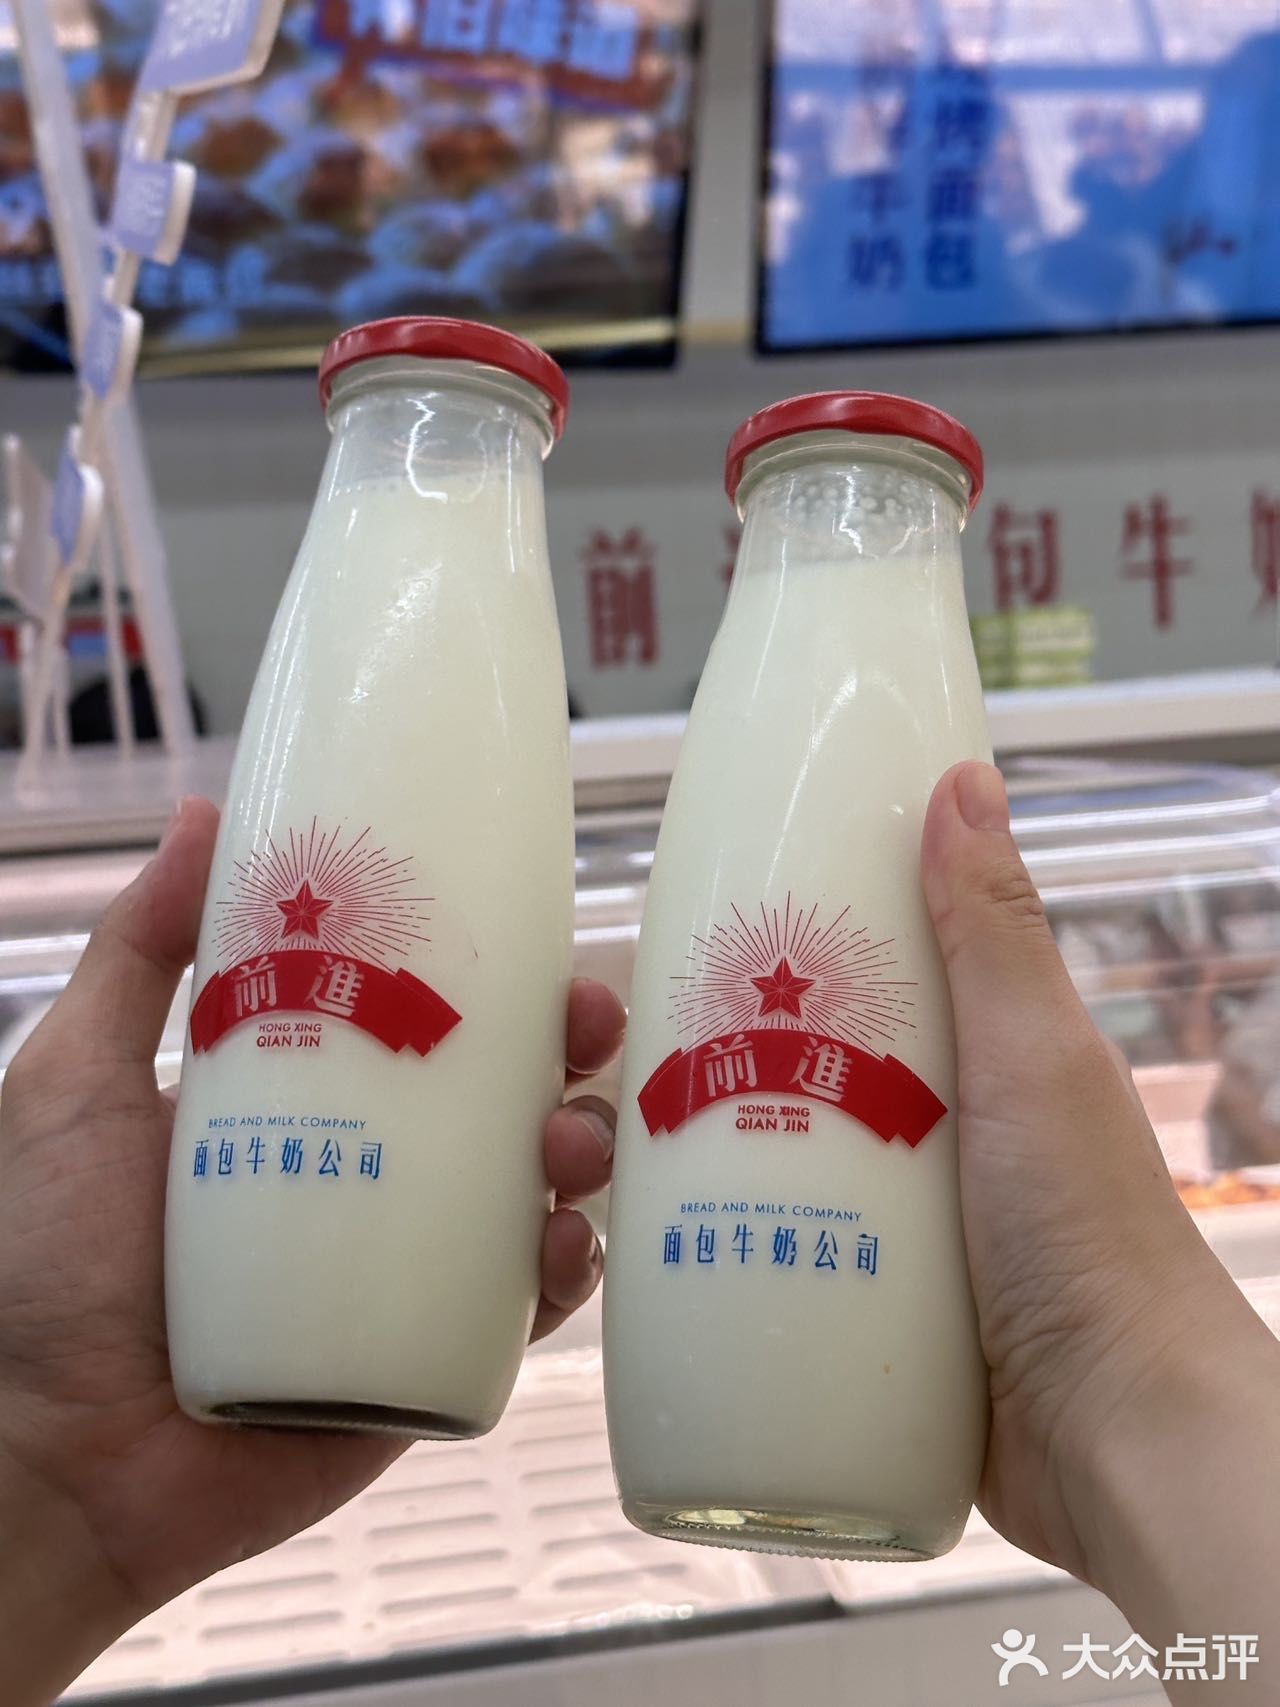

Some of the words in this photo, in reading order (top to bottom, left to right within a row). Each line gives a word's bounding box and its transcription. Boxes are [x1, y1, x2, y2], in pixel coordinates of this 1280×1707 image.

[231, 955, 364, 1017] 前進
[259, 1022, 291, 1033] HONG
[294, 1022, 322, 1033] XING
[256, 1035, 292, 1048] QIAN
[297, 1035, 320, 1048] JIN
[703, 1034, 852, 1103] 前進
[737, 1104, 775, 1115] HONG
[779, 1105, 811, 1118] XING
[208, 1117, 236, 1129] BREAD
[240, 1116, 263, 1127] AND
[267, 1116, 295, 1127] MILK
[300, 1117, 366, 1130] COMPANY
[735, 1117, 777, 1131] QIAN
[783, 1119, 810, 1132] JIN
[193, 1136, 383, 1180] 面包牛奶公司
[680, 1202, 716, 1214] BREAD
[721, 1202, 749, 1213] AND
[754, 1203, 786, 1215] MILK
[792, 1205, 862, 1222] COMPANY
[663, 1224, 878, 1276] 面包牛奶公司
